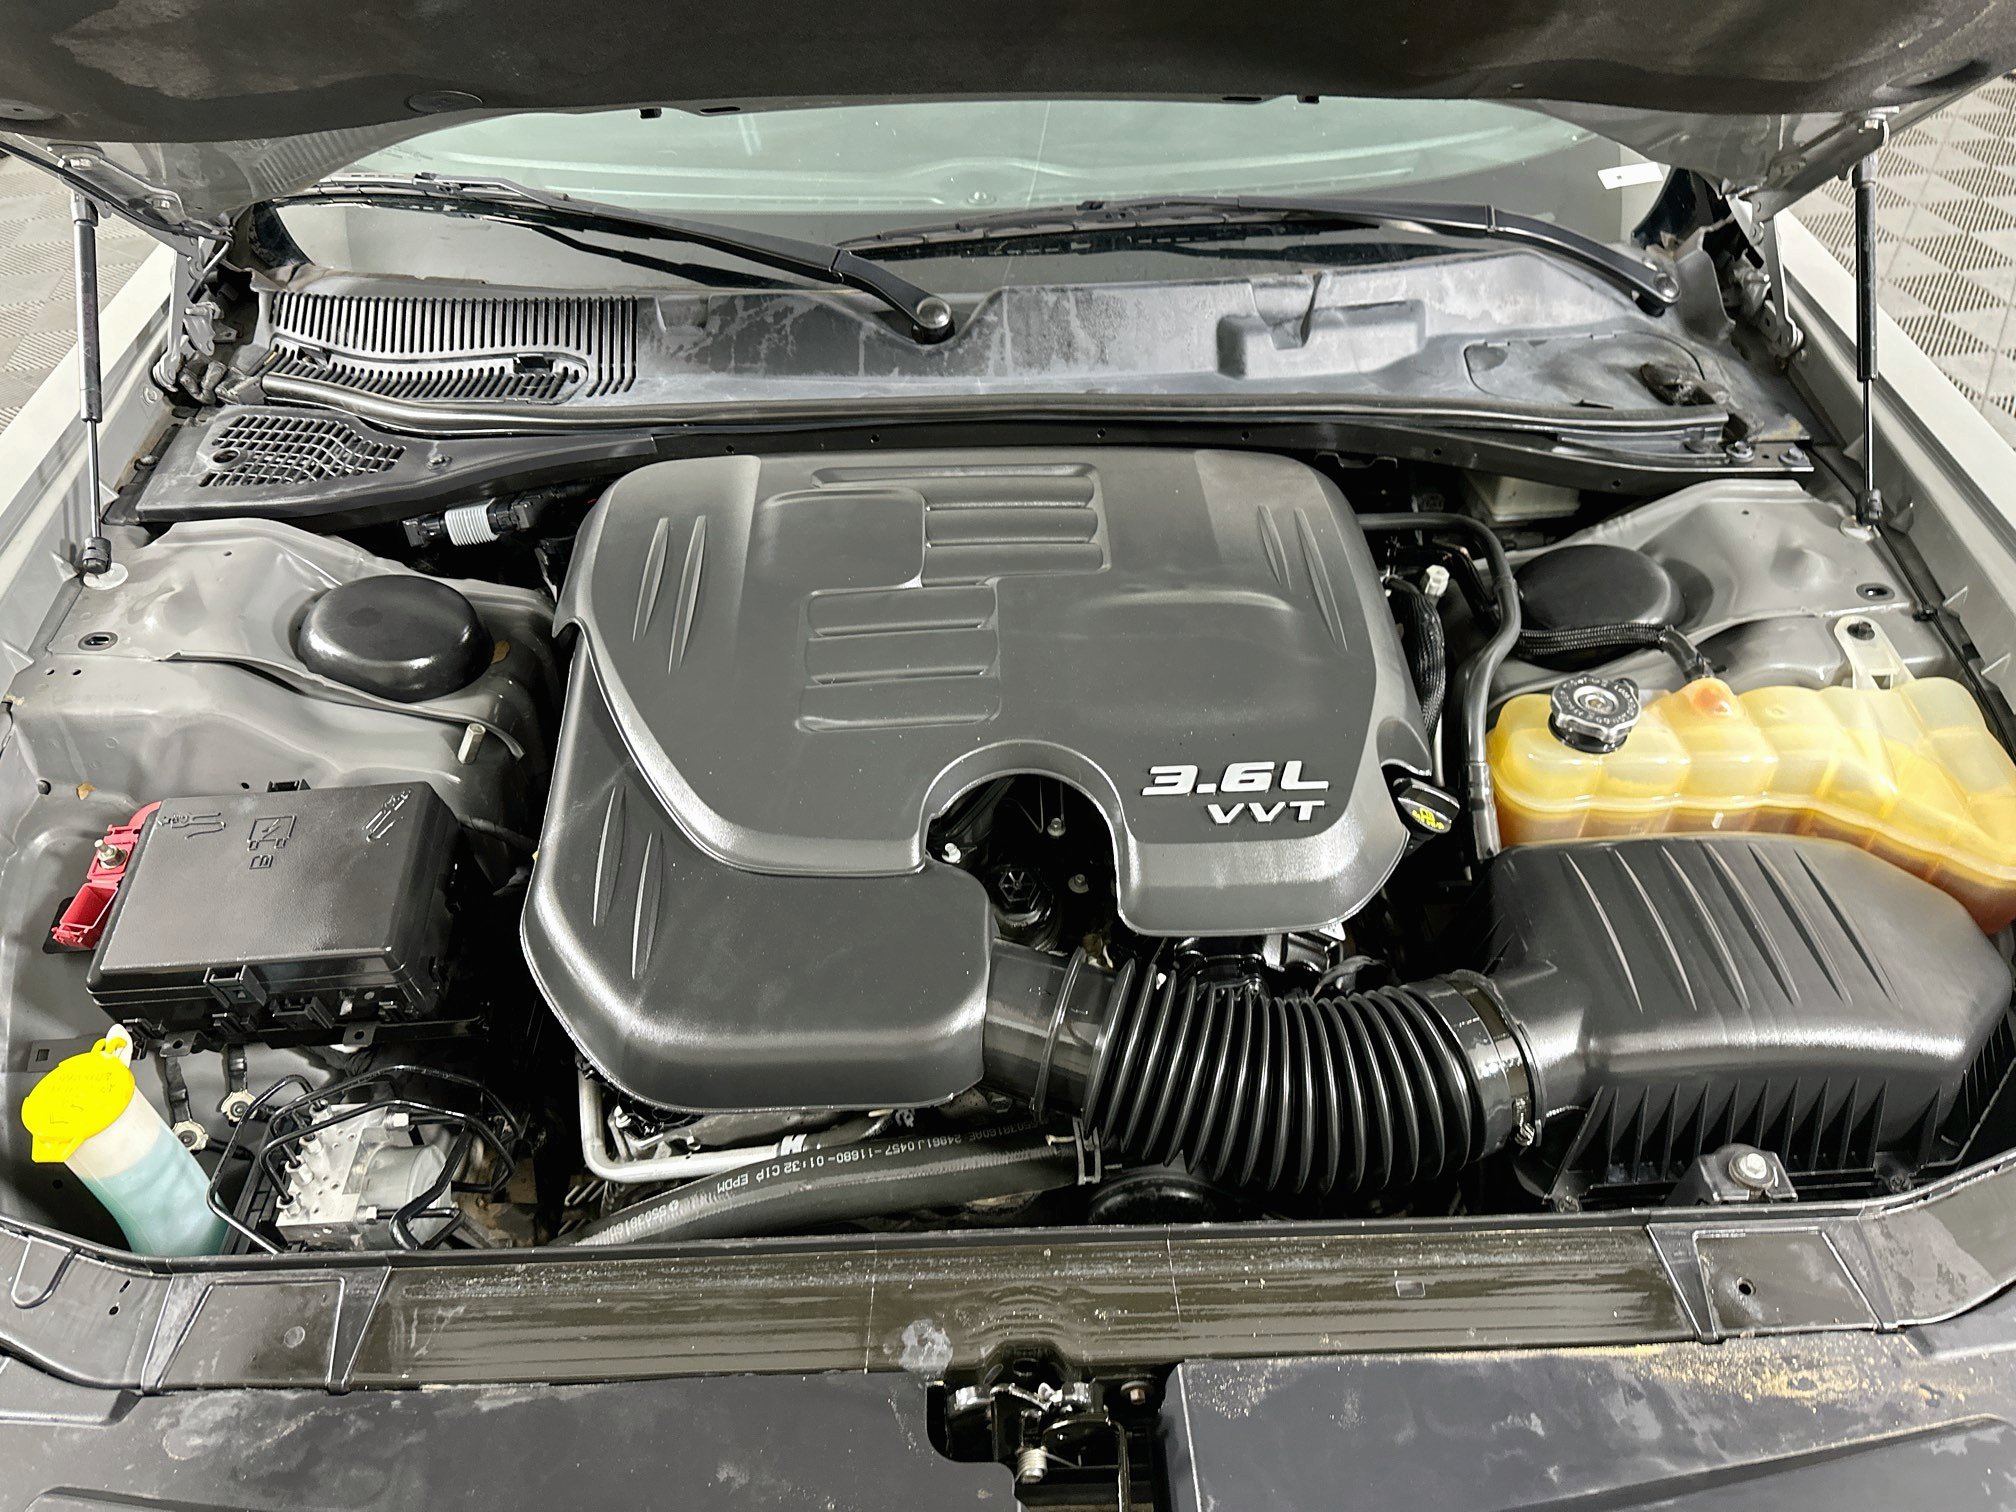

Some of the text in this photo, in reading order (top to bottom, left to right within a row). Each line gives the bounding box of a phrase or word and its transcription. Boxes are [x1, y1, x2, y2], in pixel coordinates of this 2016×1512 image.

[1141, 760, 1329, 796] 3.6L
[1206, 800, 1326, 825] VVT
[716, 1173, 749, 1194] EPDM
